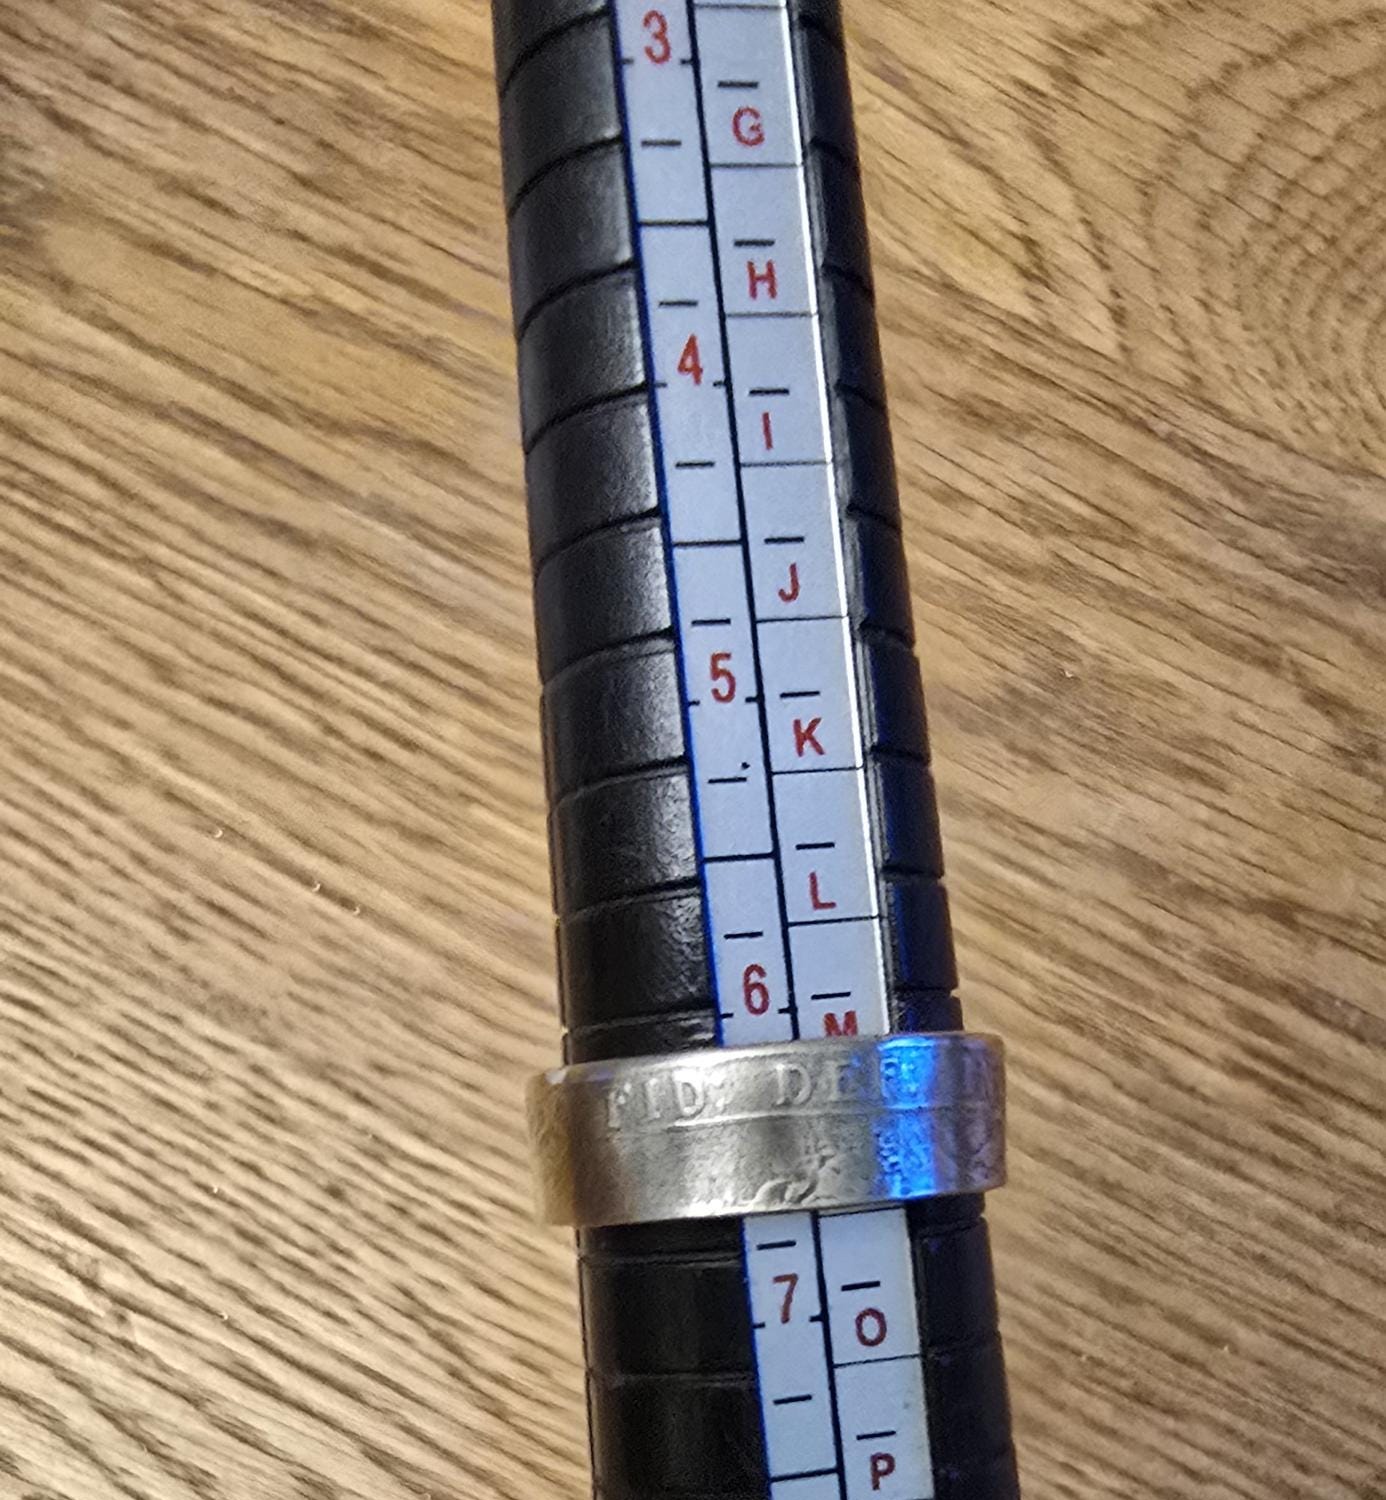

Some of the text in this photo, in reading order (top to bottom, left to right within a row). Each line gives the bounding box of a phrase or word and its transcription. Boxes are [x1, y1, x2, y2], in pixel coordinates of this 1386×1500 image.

[642, 10, 672, 65] 3
[731, 107, 765, 147] G
[747, 260, 778, 300] H
[677, 334, 704, 385] 4
[761, 411, 774, 451] I
[778, 563, 800, 603] J
[709, 652, 736, 703] 5
[792, 717, 826, 758] K
[808, 873, 836, 911] L
[743, 964, 769, 1016] 6
[823, 1010, 858, 1039] M
[772, 1273, 799, 1324] 7
[855, 1308, 887, 1347] O
[870, 1452, 896, 1491] P
